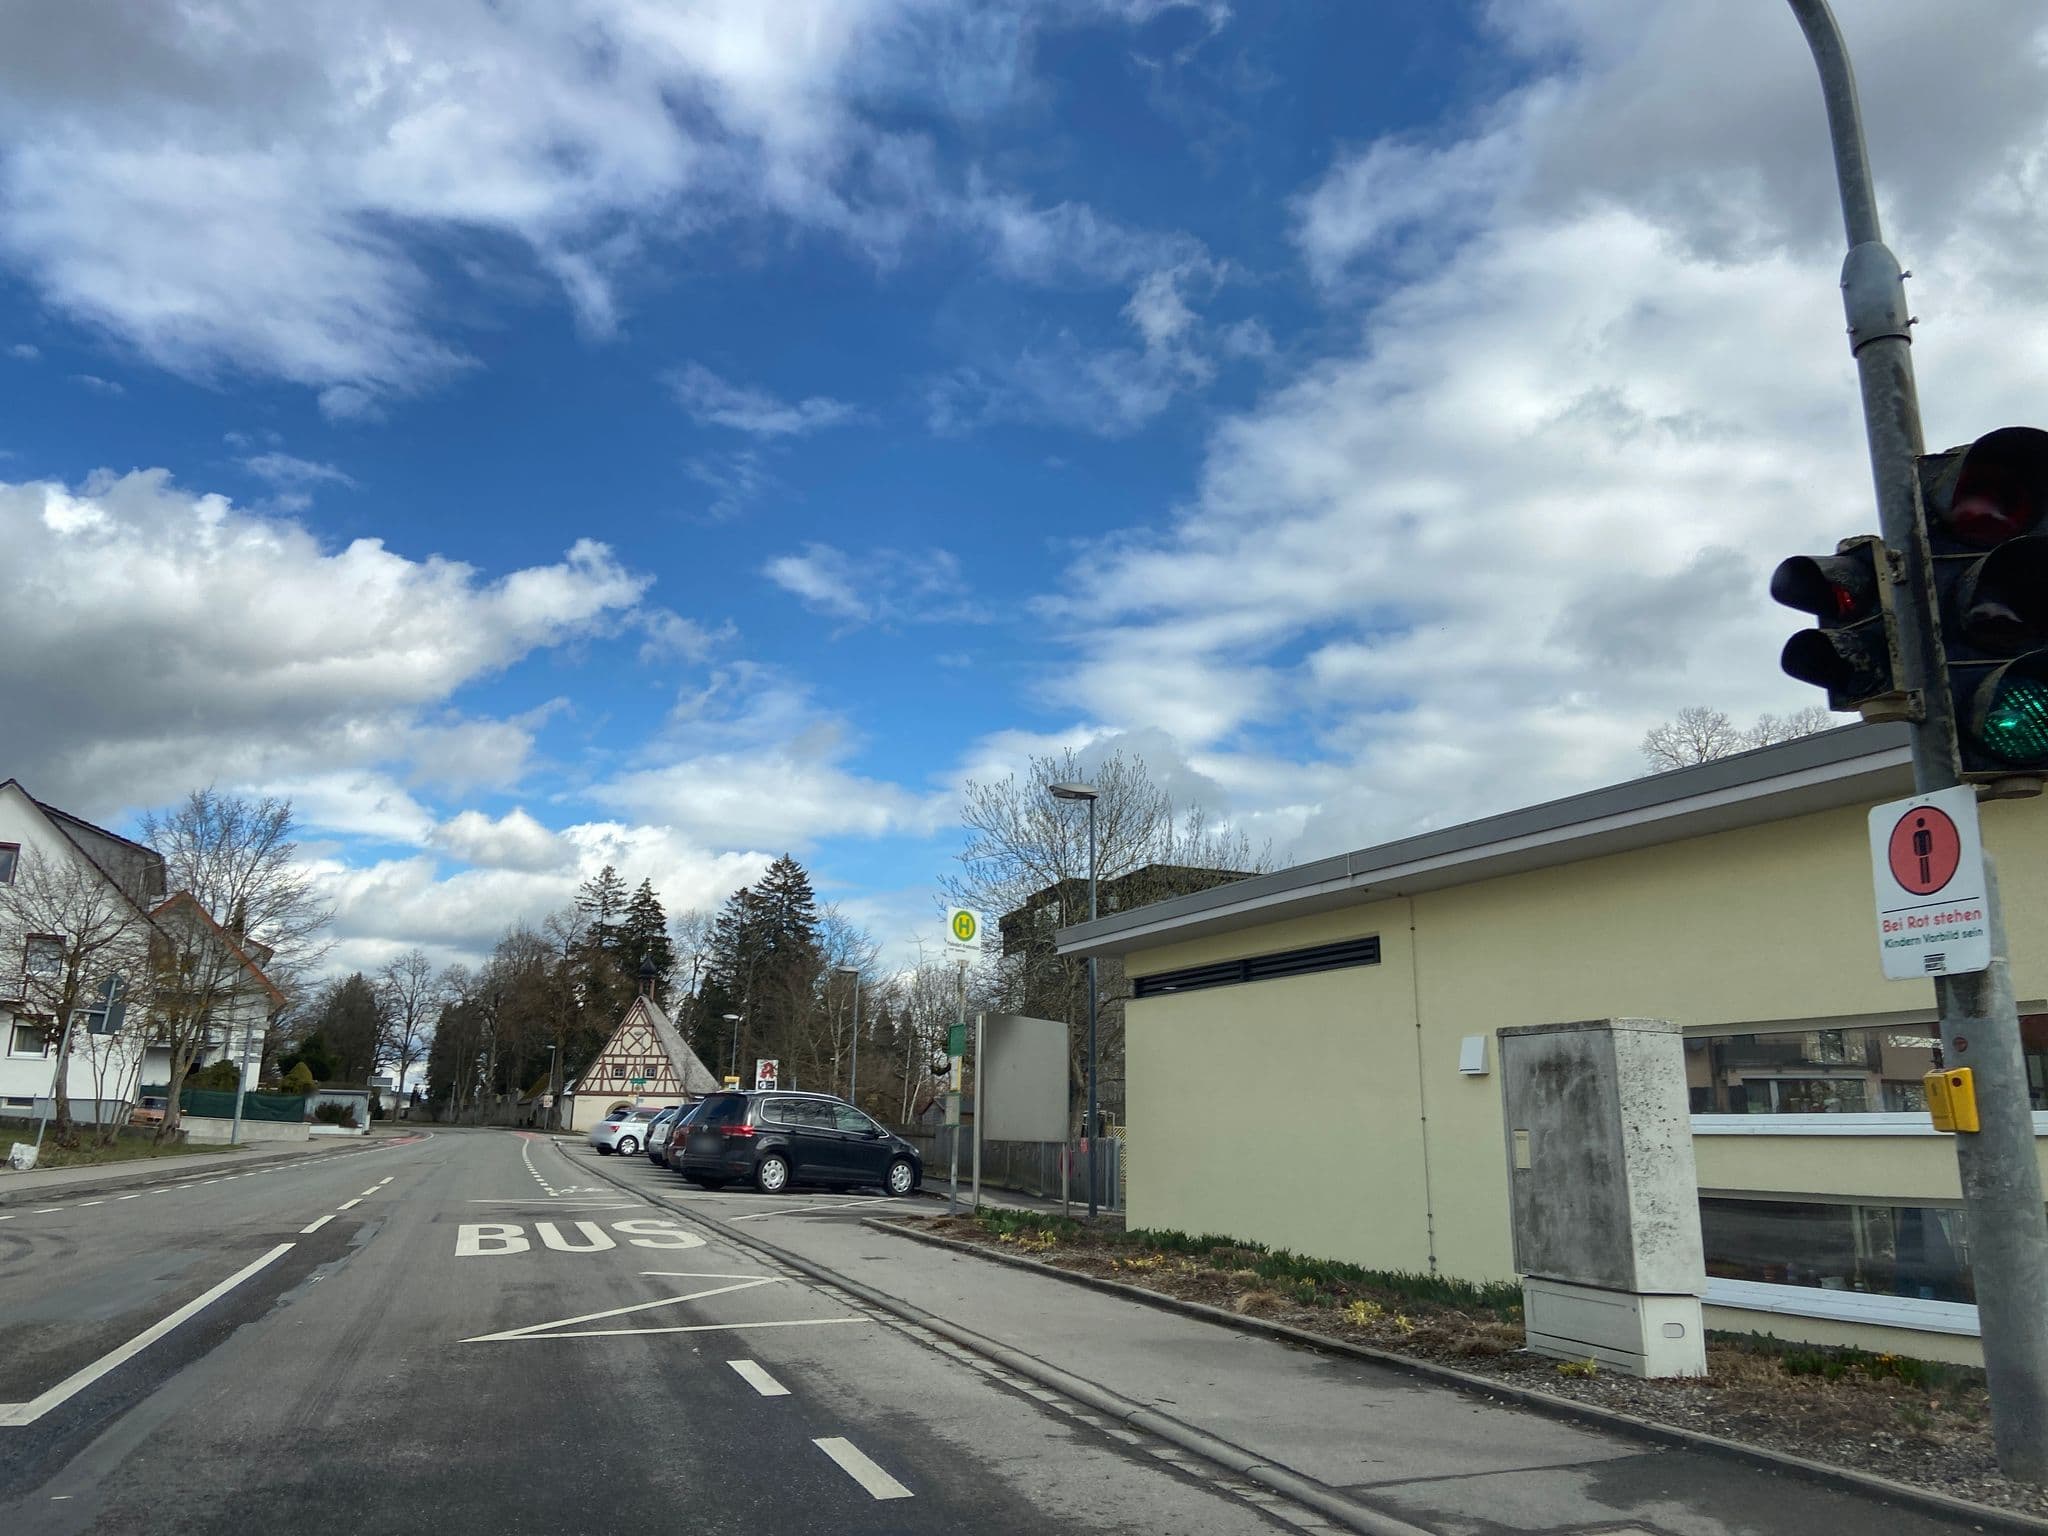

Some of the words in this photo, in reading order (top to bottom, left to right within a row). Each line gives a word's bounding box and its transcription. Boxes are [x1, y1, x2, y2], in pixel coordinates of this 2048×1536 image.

[958, 916, 970, 935] H
[1882, 918, 1903, 932] Bei
[1907, 914, 1929, 929] Rot
[1934, 909, 1982, 925] stehen
[1884, 936, 1921, 948] Kindern
[1923, 929, 1959, 943] Vorbild
[1962, 927, 1984, 938] sein
[454, 1219, 707, 1257] BUS
